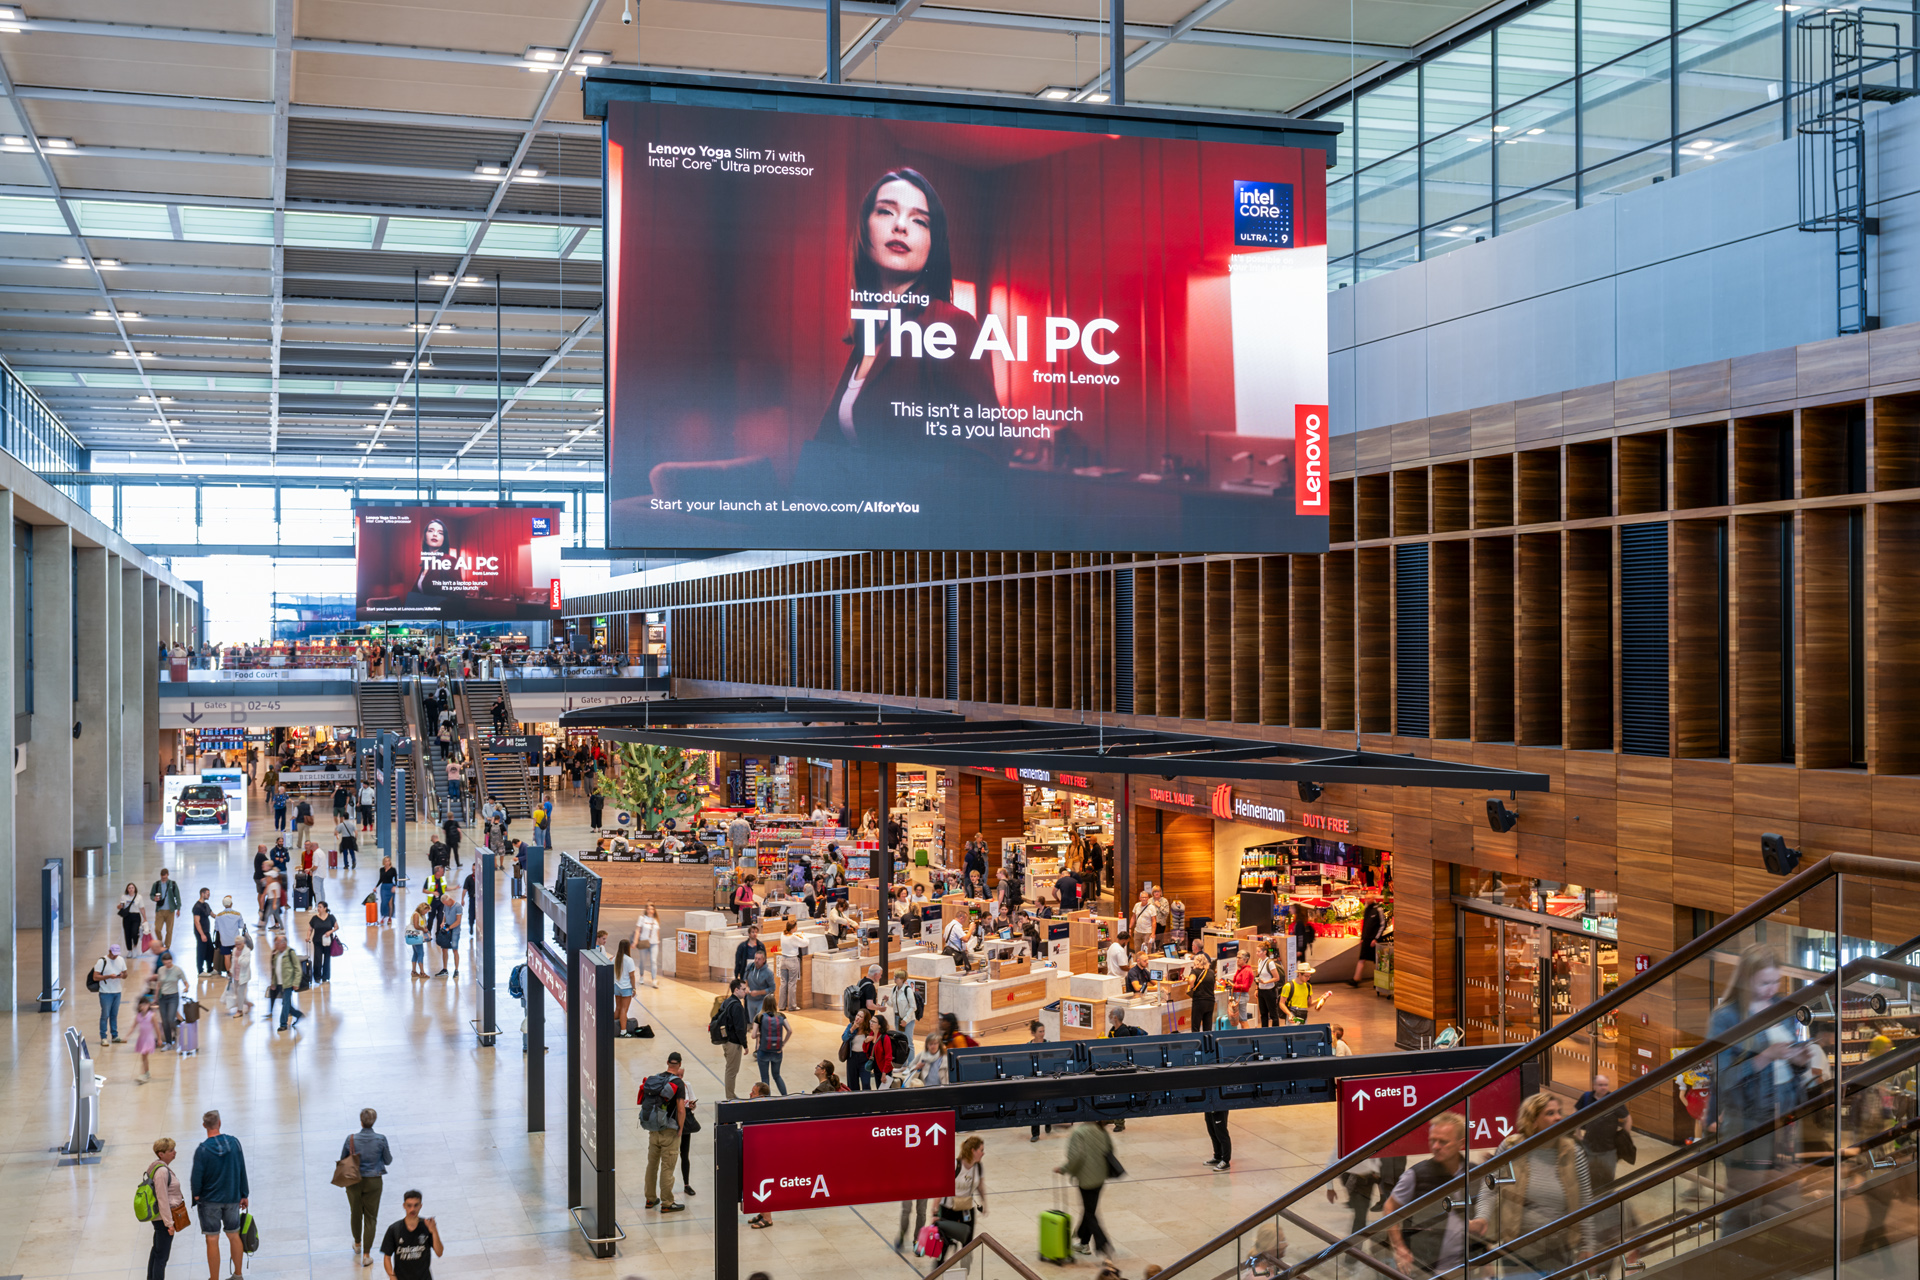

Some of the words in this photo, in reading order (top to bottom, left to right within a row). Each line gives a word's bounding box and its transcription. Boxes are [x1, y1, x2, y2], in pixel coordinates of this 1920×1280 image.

[648, 142, 696, 156] Lenovo
[699, 145, 732, 160] Yoga
[735, 148, 761, 160] Slim
[764, 150, 775, 161] 7i
[778, 151, 805, 163] with
[720, 160, 750, 172] Ultra
[753, 164, 814, 176] processor
[1240, 188, 1274, 205] intel
[1281, 234, 1288, 243] 9
[850, 289, 930, 306] Introducing
[851, 308, 957, 359] The
[969, 314, 1028, 362] AI
[1045, 316, 1120, 365] PC
[1033, 370, 1066, 383] from
[1070, 371, 1120, 385] Lenovo
[891, 402, 924, 417] This
[928, 403, 959, 418] isn't
[964, 407, 973, 419] a
[978, 404, 1028, 423] laptop
[1032, 406, 1083, 421] launch
[926, 421, 948, 436] It's
[952, 426, 961, 436] a
[966, 425, 994, 439] you
[1000, 423, 1050, 438] launch
[1303, 414, 1321, 506] Lenovo
[650, 498, 682, 510] Start
[686, 501, 715, 512] your
[719, 500, 762, 511] launch
[765, 501, 778, 512] at
[782, 500, 920, 514] Lenovo.com/AIforYou
[421, 556, 452, 570] The
[454, 556, 472, 570] AI
[476, 556, 499, 570] PC
[231, 702, 247, 723] B
[1020, 768, 1050, 782] Heinemann
[1060, 774, 1074, 785] DUTY
[1074, 776, 1087, 788] FREE
[1149, 788, 1173, 803] TRAVEL
[1173, 792, 1195, 807] VALUE
[1235, 798, 1285, 823] Heinemann
[1303, 813, 1325, 830] DUTY
[1327, 817, 1350, 834] FREE
[1374, 1087, 1401, 1098] Gates
[1403, 1085, 1417, 1107] B
[872, 1126, 902, 1138] Gates
[905, 1124, 921, 1148] B
[1474, 1118, 1492, 1140] A
[780, 1176, 811, 1188] Gates
[810, 1174, 830, 1198] A
